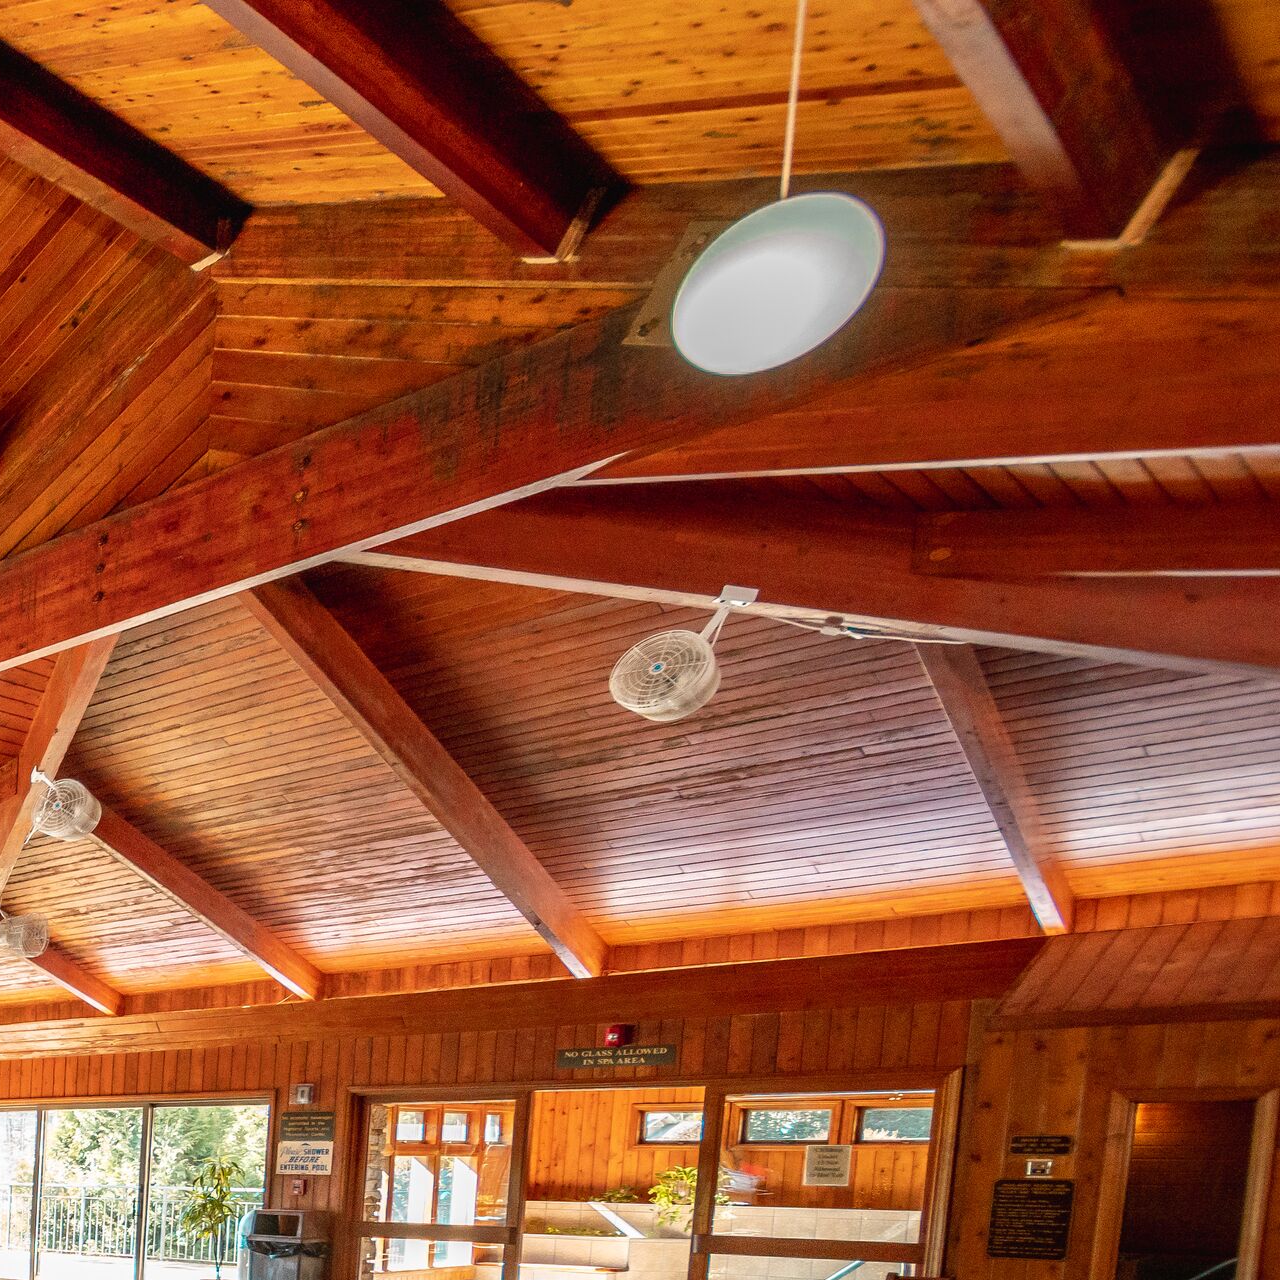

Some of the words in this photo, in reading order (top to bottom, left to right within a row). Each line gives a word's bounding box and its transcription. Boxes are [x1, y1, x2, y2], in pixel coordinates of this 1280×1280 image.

[581, 1049, 613, 1058] GLASS
[615, 1047, 668, 1056] ALLOWED
[616, 1057, 646, 1065] AREA
